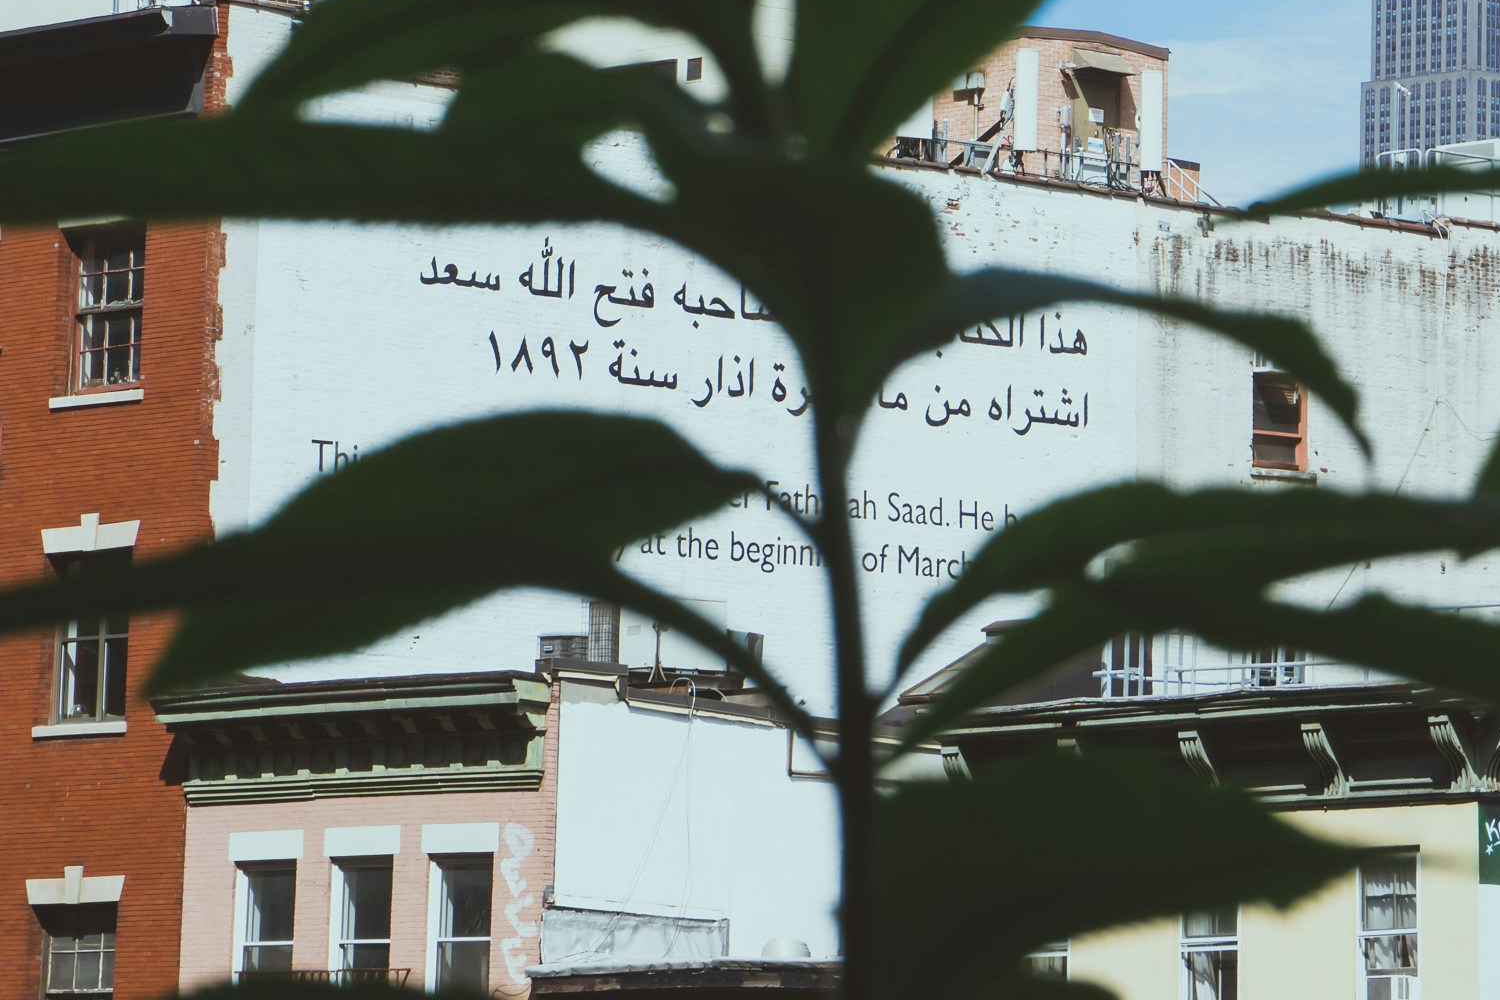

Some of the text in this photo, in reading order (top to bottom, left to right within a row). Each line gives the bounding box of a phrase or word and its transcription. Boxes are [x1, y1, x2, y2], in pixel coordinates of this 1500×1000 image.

[419, 255, 501, 292] سعد
[594, 267, 655, 328] فتح
[488, 329, 590, 382] ١٨٩٢
[1039, 311, 1088, 356] هذا
[608, 338, 678, 391] سنة
[925, 384, 972, 428] من
[987, 383, 1089, 436] اشتراه
[311, 438, 360, 473] Thi
[887, 491, 950, 527] Saad.
[959, 499, 995, 532] He
[676, 526, 720, 561] the
[862, 543, 889, 574] of
